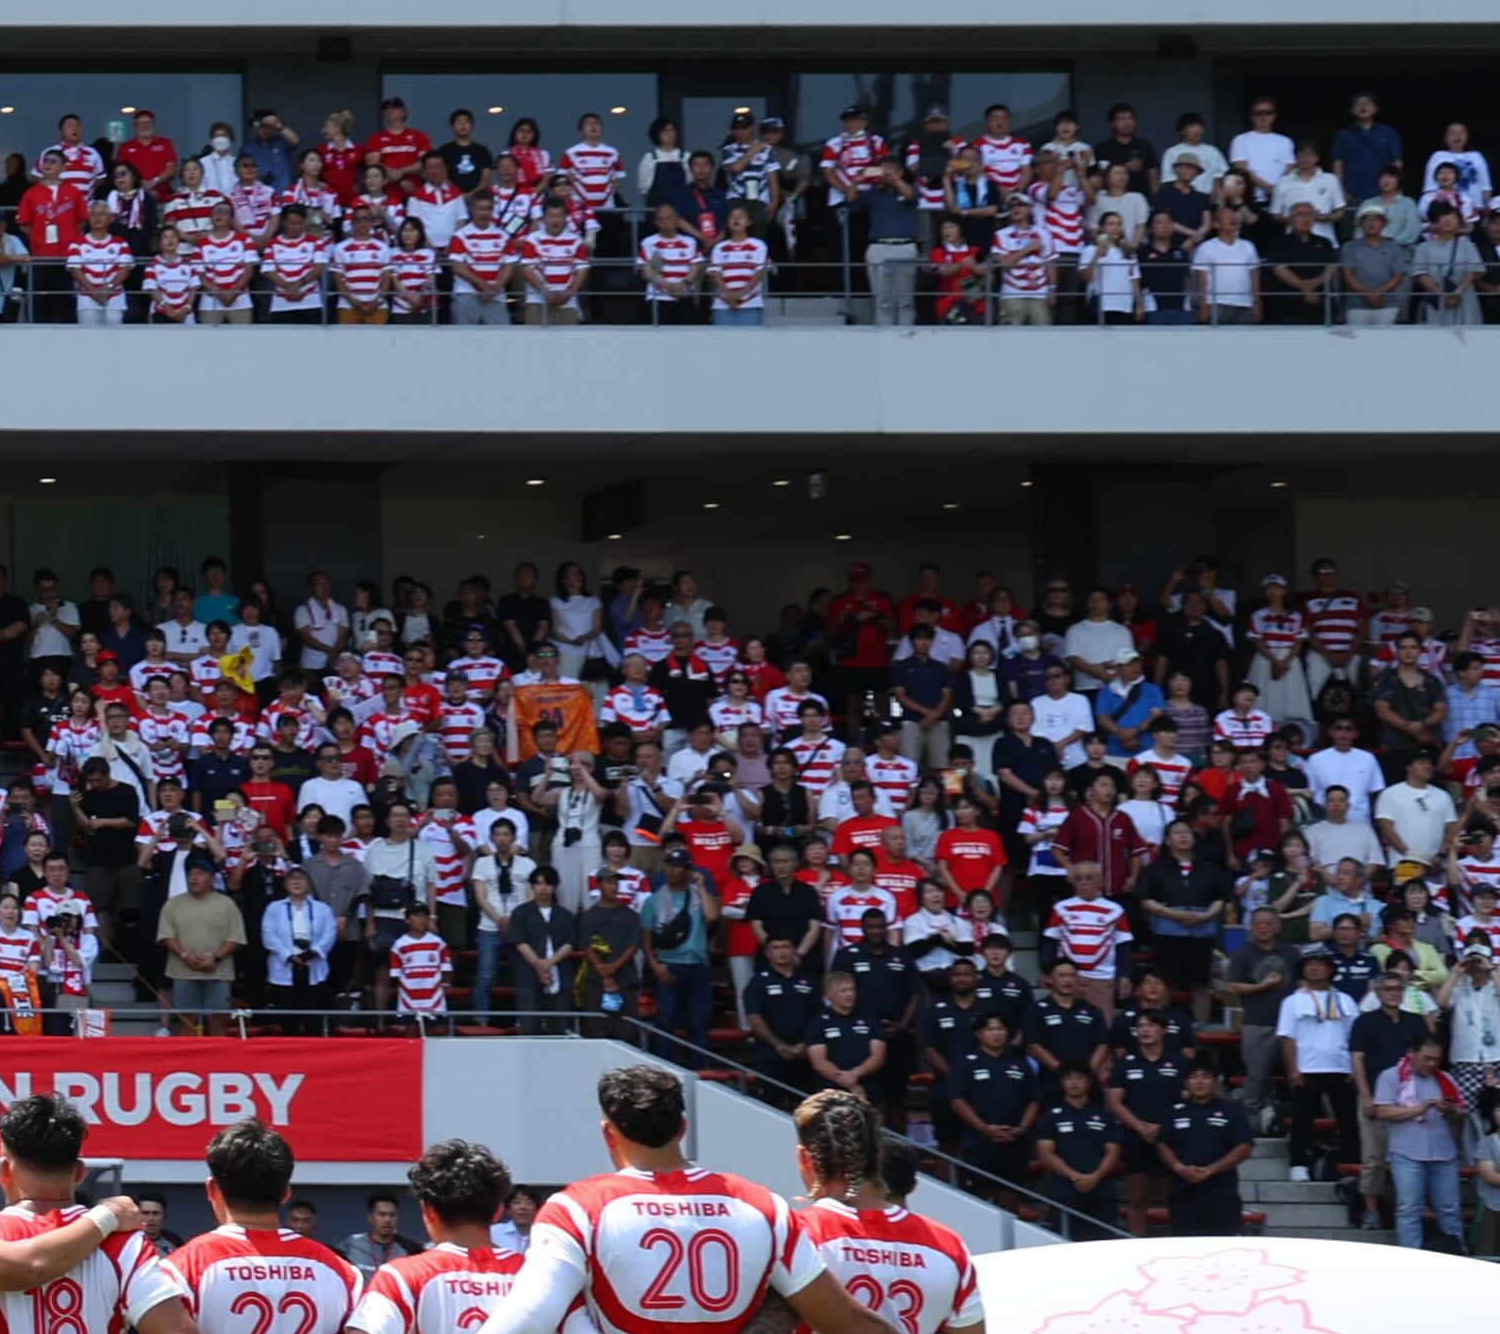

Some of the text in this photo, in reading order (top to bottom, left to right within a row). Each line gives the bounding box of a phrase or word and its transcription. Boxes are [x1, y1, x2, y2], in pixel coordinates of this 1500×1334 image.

[54, 1072, 305, 1126] RUGBY
[632, 1201, 730, 1219] TOSHIBA
[842, 1246, 926, 1269] TOSHIBA
[224, 1265, 315, 1283] TOSHIBA
[639, 1228, 740, 1313] 20
